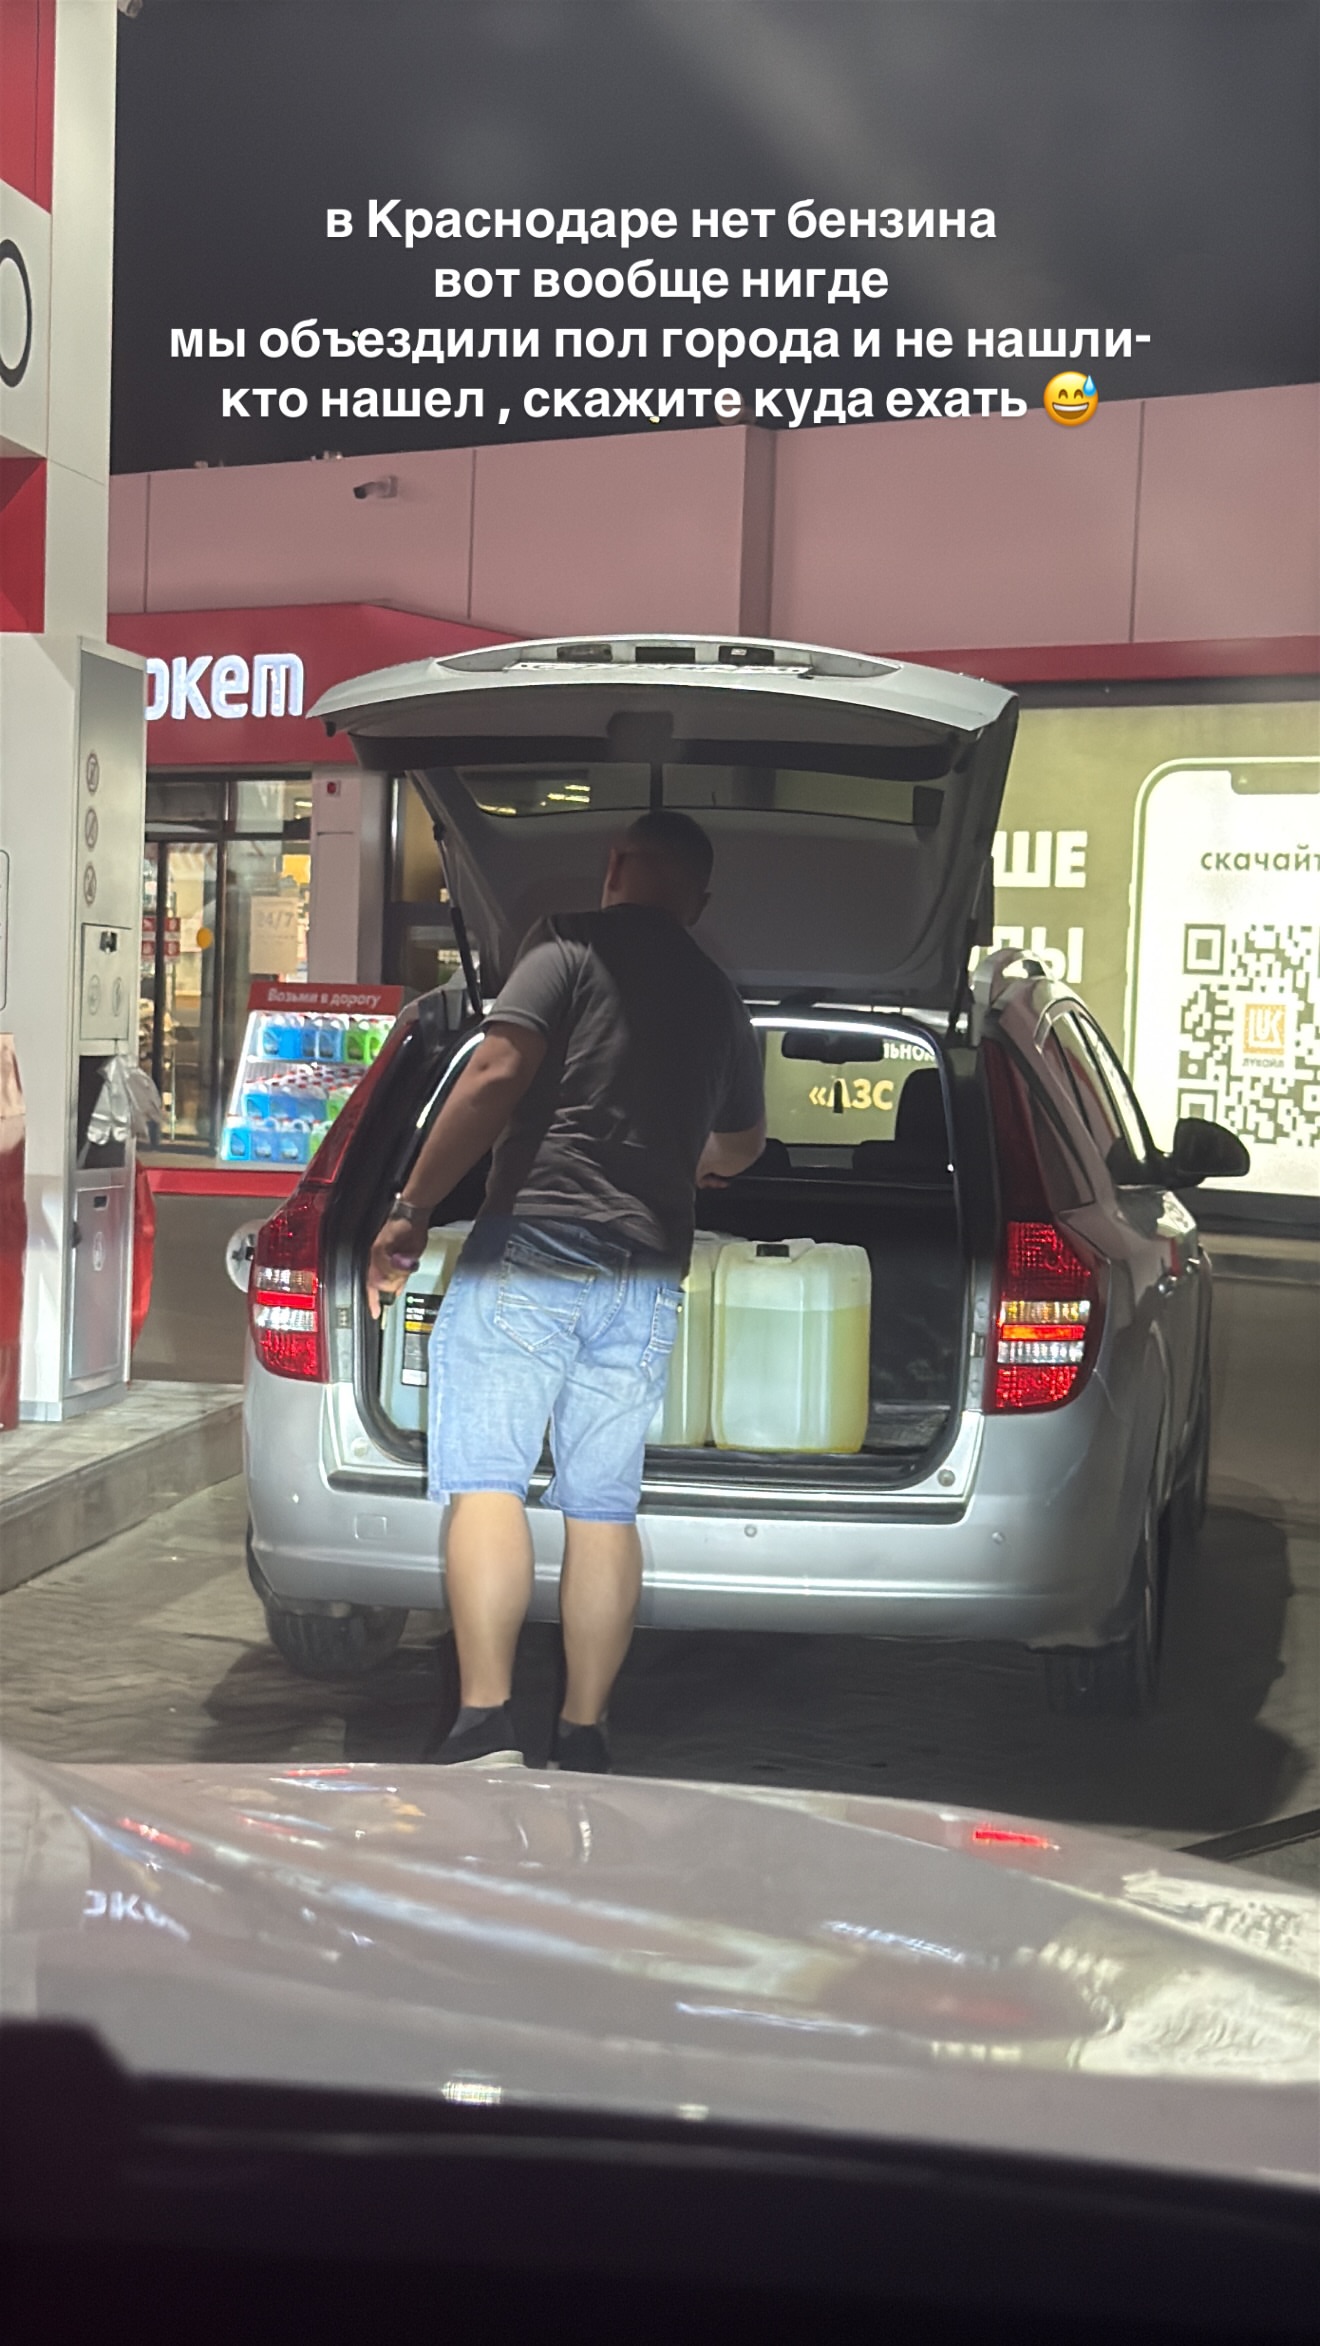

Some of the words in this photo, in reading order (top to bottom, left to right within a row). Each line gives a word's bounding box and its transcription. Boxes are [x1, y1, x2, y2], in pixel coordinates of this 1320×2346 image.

[255, 911, 295, 930] 24/7
[267, 987, 318, 1004] Возьми
[319, 991, 328, 1004] в
[329, 992, 382, 1009] дорогу
